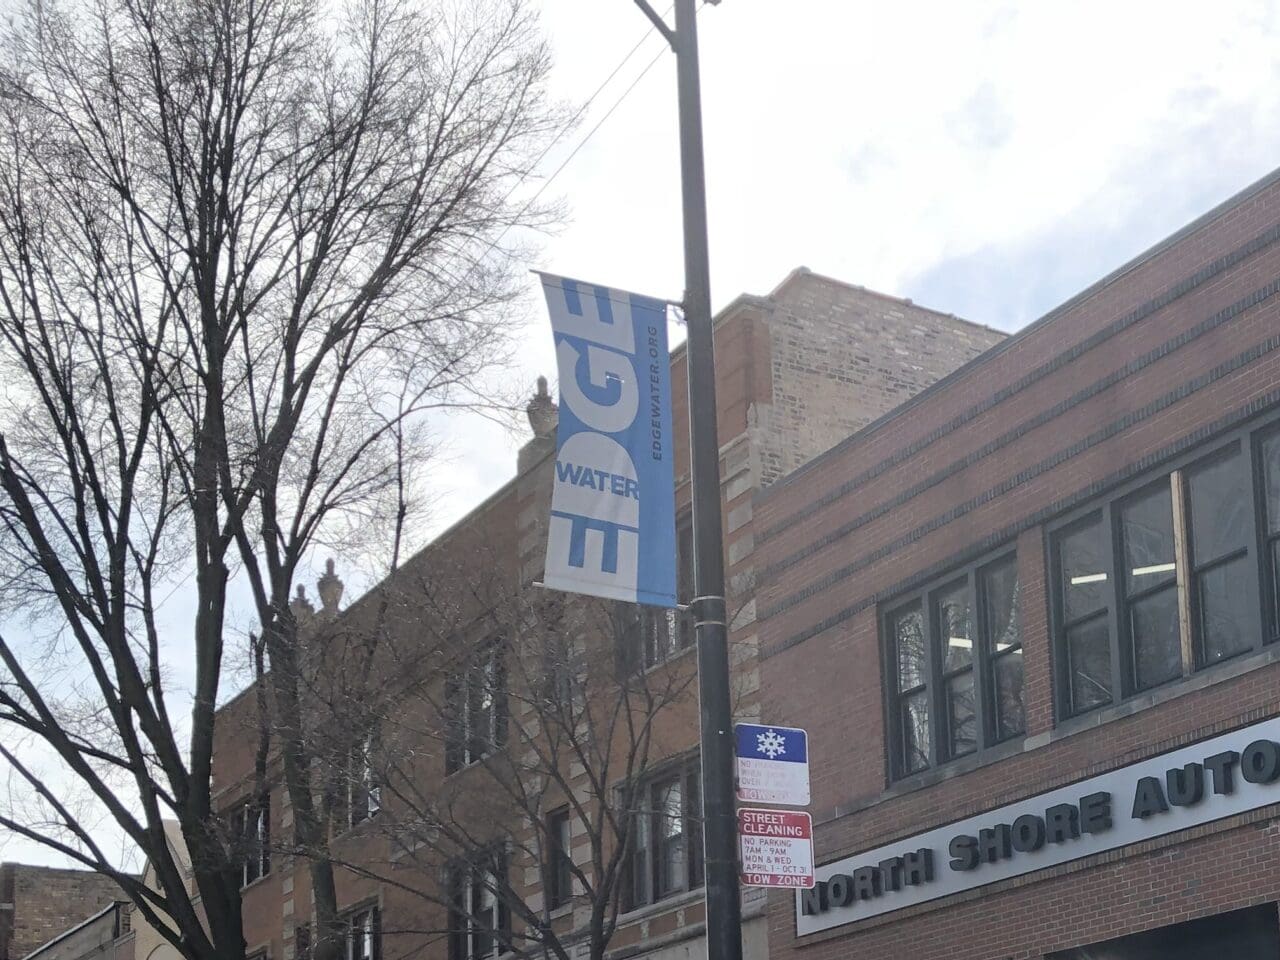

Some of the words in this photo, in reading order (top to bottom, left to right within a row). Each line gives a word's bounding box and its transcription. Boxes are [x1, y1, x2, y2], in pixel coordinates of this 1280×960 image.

[650, 325, 663, 462] EDGEWATER.ORG
[544, 272, 640, 604] EDGE
[555, 460, 640, 501] WATER
[743, 812, 785, 825] STREET
[743, 823, 803, 836] CLEANING
[744, 838, 755, 846] NO
[759, 838, 792, 848] PARKING
[745, 846, 761, 854] 7AM
[769, 847, 786, 856] 9AM
[802, 848, 935, 916] NORTH
[949, 791, 1113, 871] SHORE
[745, 855, 763, 863] MON
[766, 856, 772, 864] &
[774, 856, 792, 865] WED
[746, 864, 769, 872] APRIL
[782, 865, 797, 874] OCT
[799, 866, 807, 874] 31
[746, 874, 771, 884] TOW
[777, 875, 808, 886] ZONE
